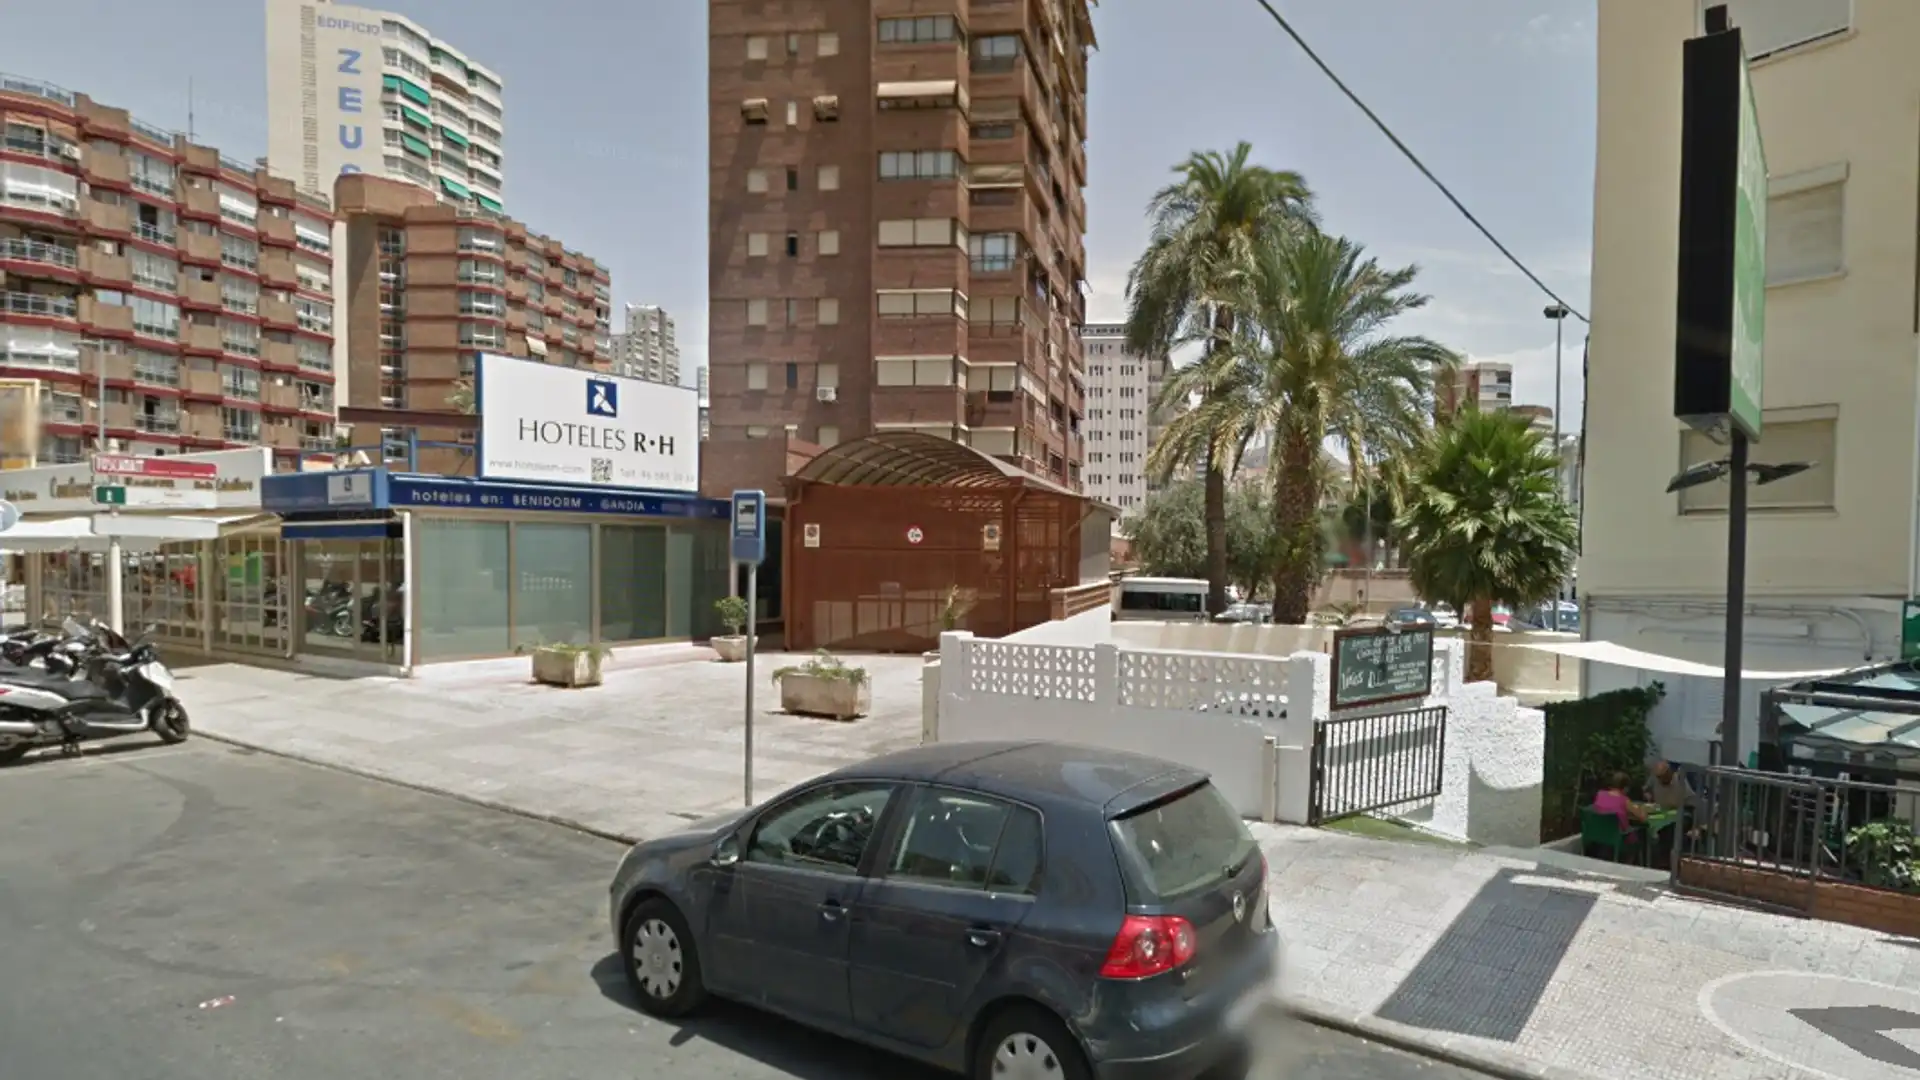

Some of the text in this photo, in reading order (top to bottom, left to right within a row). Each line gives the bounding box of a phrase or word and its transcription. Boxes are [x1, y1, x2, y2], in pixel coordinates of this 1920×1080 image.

[317, 15, 380, 36] EDIFICIO
[518, 417, 627, 452] HOTELES
[412, 489, 471, 504] hoteles
[480, 493, 503, 505] en:
[512, 494, 582, 509] BENIDORM
[600, 498, 645, 512] GANDIA
